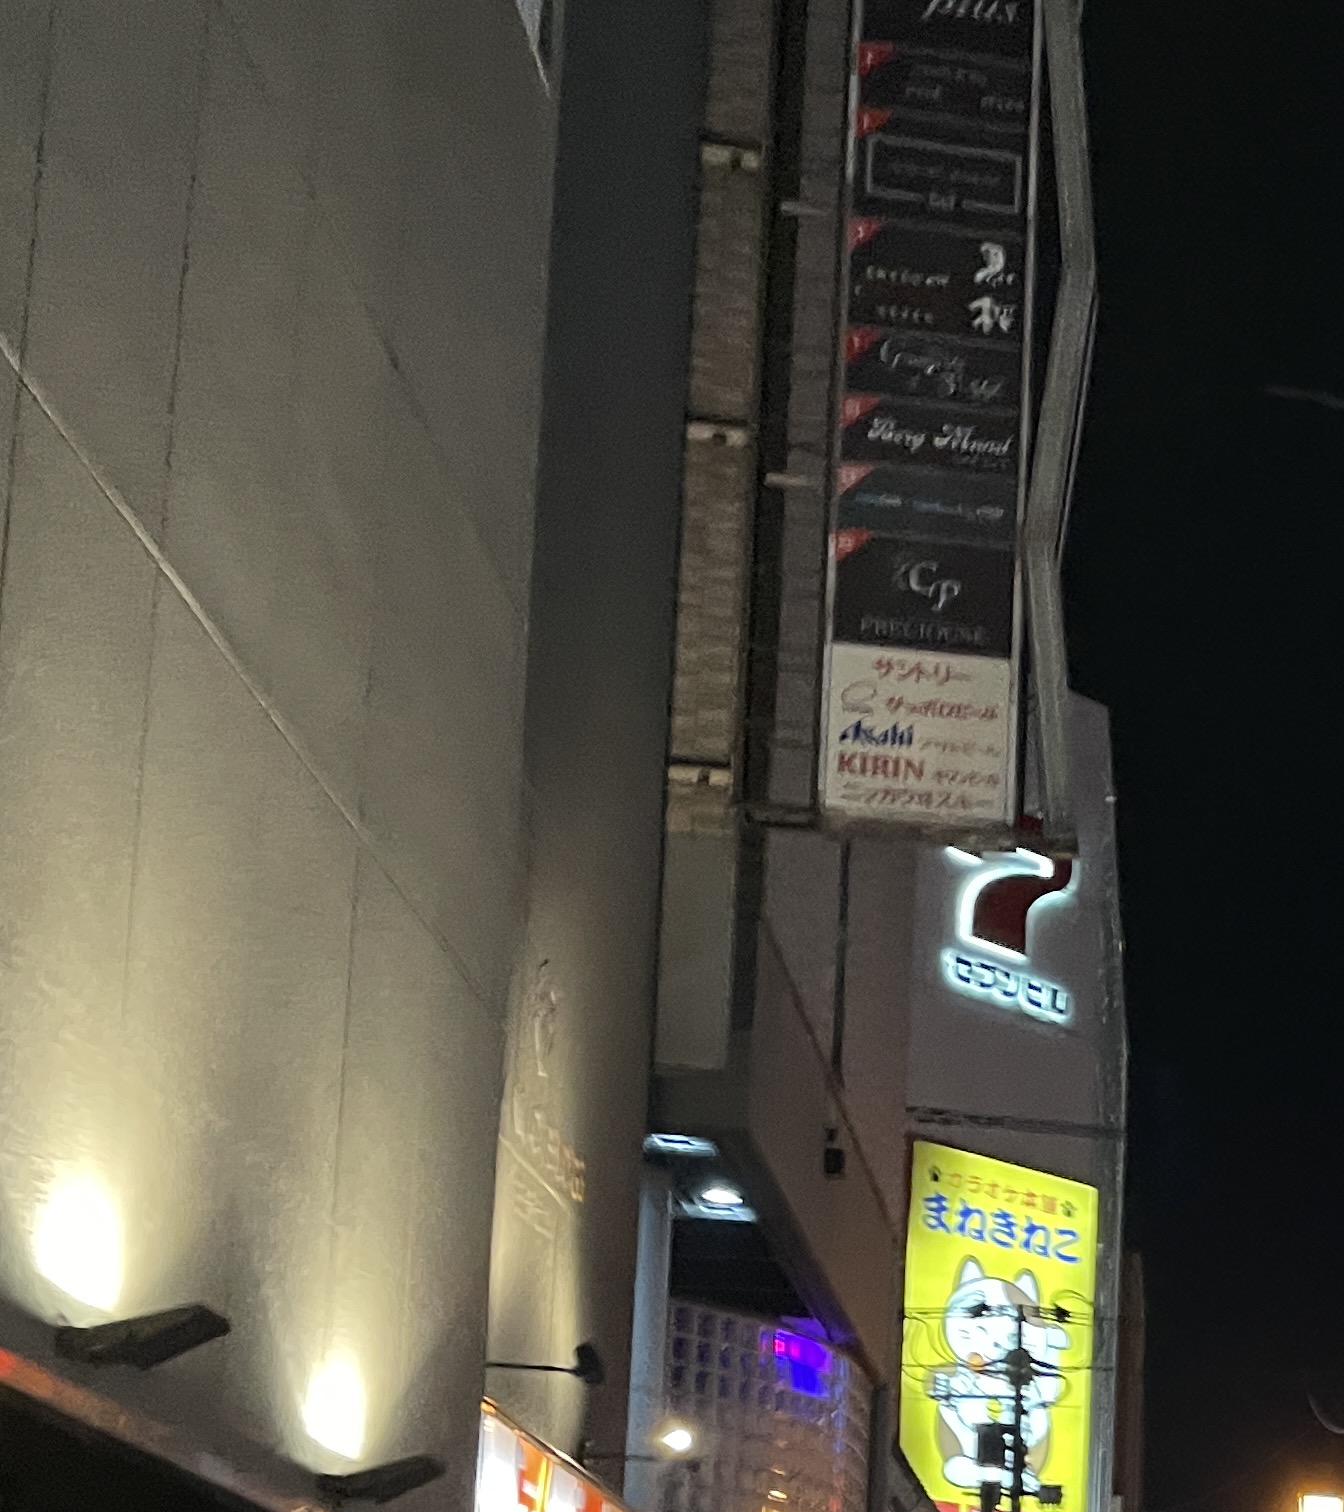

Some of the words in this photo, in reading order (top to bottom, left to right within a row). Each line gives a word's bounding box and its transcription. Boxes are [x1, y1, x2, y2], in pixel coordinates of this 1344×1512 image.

[839, 719, 914, 748] Asahi
[837, 750, 925, 782] KIRIN
[921, 1192, 1081, 1265] まねきねこ
